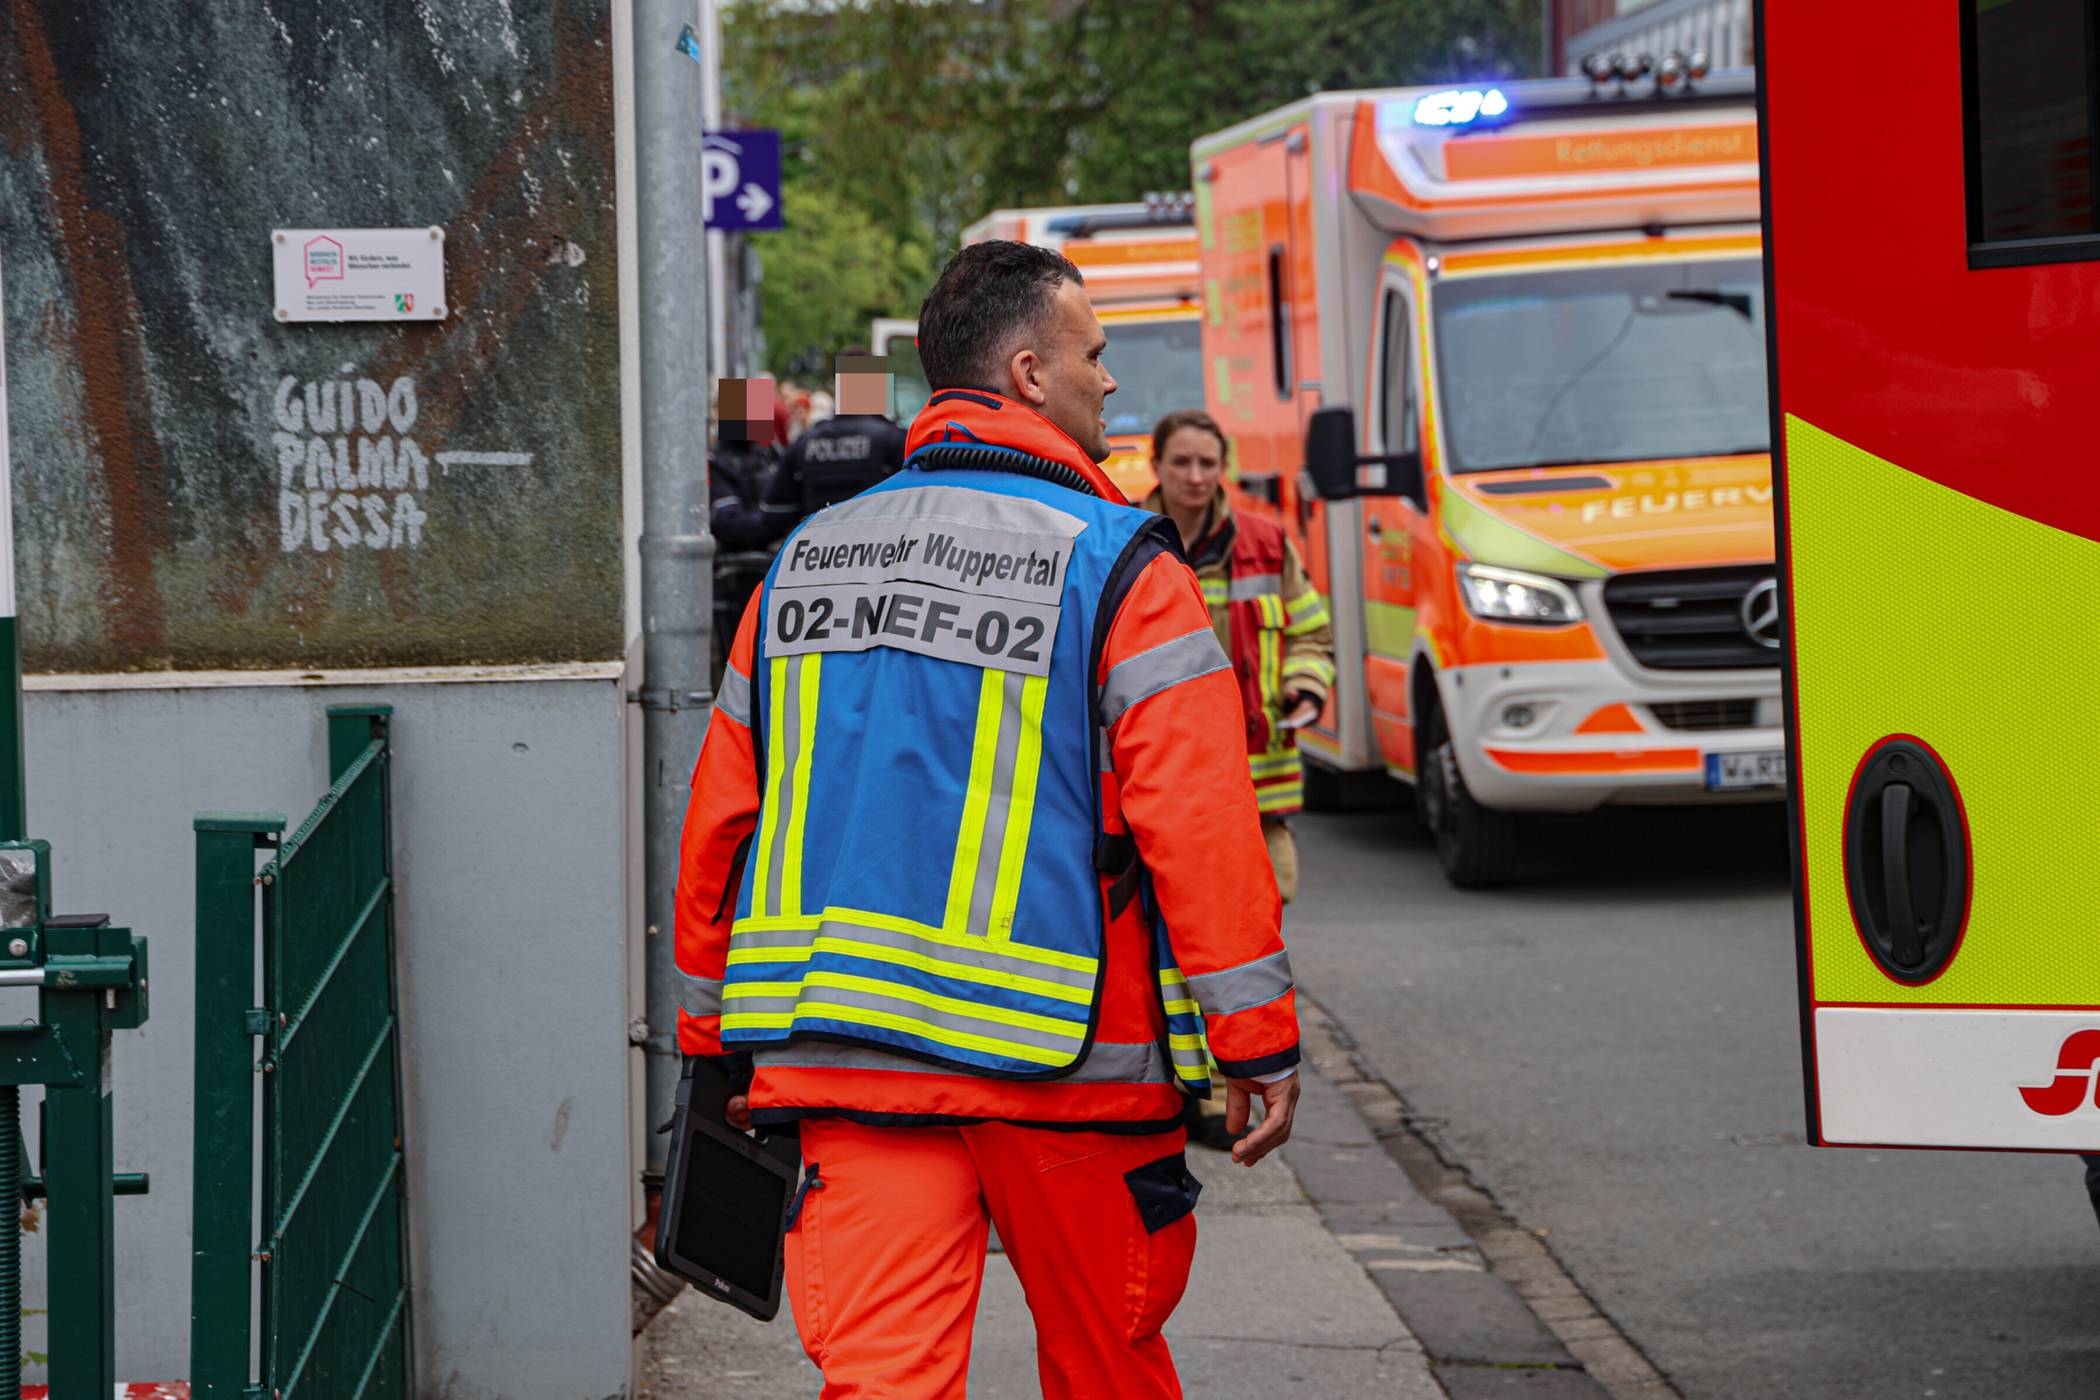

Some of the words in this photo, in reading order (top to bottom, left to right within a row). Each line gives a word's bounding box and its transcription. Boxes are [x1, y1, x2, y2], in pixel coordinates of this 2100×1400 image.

[702, 149, 739, 222] P
[274, 362, 418, 434] GUIDO
[273, 430, 429, 491] PALMA
[804, 434, 872, 462] POLIZEI
[279, 488, 428, 552] DESSA
[789, 533, 920, 573] Feuerwehr
[922, 532, 1060, 587] Wuppertal
[776, 593, 1046, 663] 02-NEF-02
[2017, 1028, 2100, 1116] S
